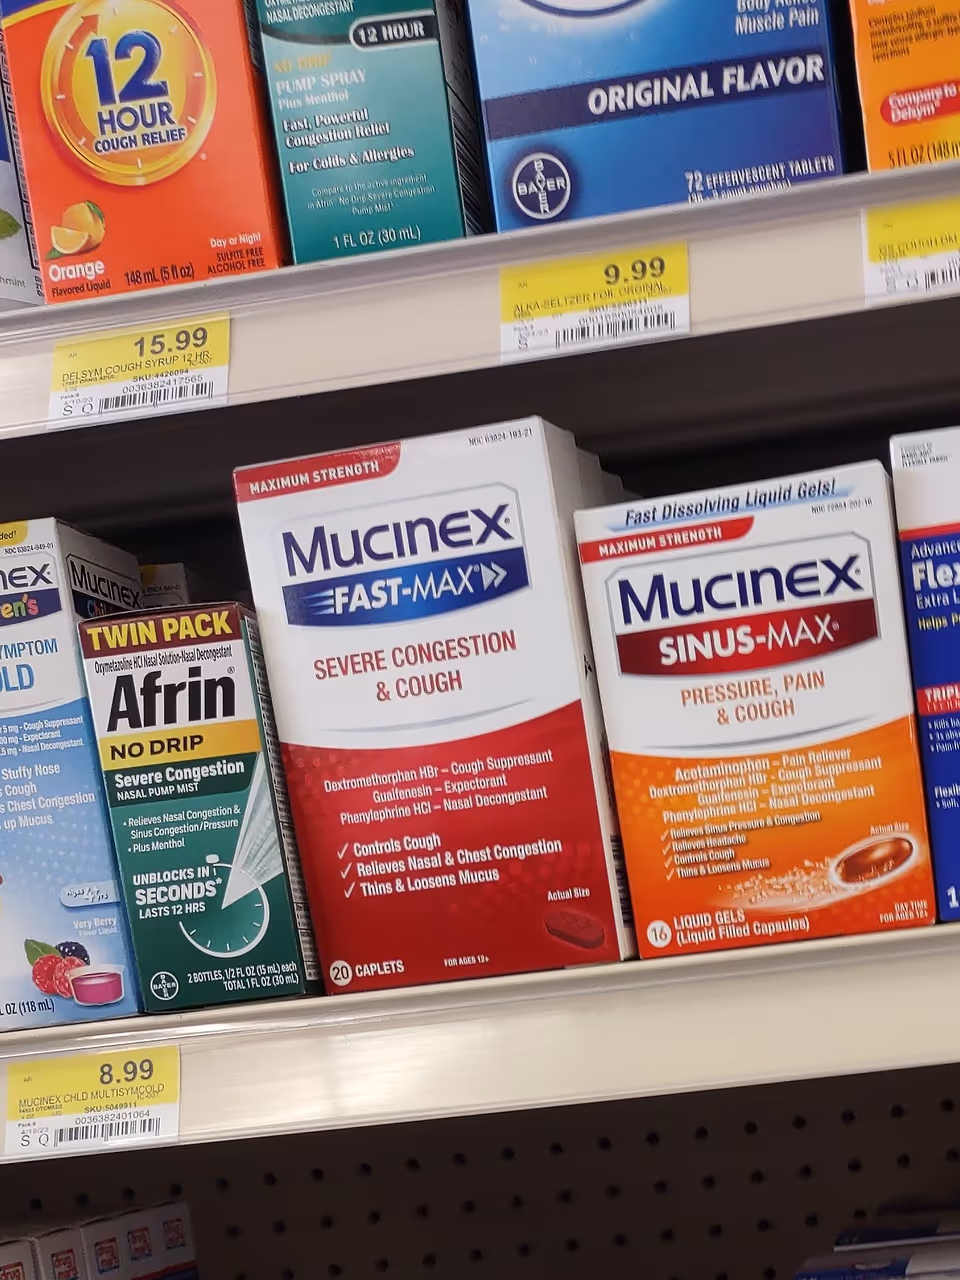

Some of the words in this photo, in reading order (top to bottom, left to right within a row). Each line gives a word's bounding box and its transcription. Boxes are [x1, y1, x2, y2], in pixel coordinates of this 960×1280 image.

[357, 26, 377, 44] 12
[381, 21, 425, 41] HOUR
[85, 29, 169, 106] 12
[588, 77, 714, 116] ORIGINAL
[722, 54, 824, 94] FLAVOR
[97, 102, 174, 136] HOUR
[94, 134, 139, 153] COUGH
[141, 129, 186, 146] RELIEF
[48, 260, 105, 282] Orange
[207, 260, 243, 274] ALCOHOL
[245, 257, 265, 270] FREE
[604, 257, 666, 285] 9.99
[134, 326, 209, 358] 15.99
[62, 367, 102, 383] DELSYM
[105, 360, 142, 376] COUGH
[145, 355, 180, 370] SYRUP
[250, 474, 309, 494] MAXIMUM
[314, 461, 380, 482] STRENGTH
[625, 508, 658, 528] Fast
[662, 491, 740, 521] Dissolving
[746, 482, 793, 509] Liquid
[798, 478, 836, 498] Gels!
[87, 622, 157, 651] TWIN
[164, 611, 232, 639] PACK
[314, 649, 387, 681] SEVERE
[392, 629, 517, 668] CONGESTION
[376, 681, 391, 701] &
[396, 670, 462, 699] COUGH
[681, 677, 778, 708] PRESSURE,
[784, 670, 826, 693] PAIN
[716, 706, 729, 726] &
[736, 698, 795, 723] COUGH
[110, 742, 144, 760] NO
[150, 734, 204, 751] DRIP
[115, 767, 163, 789] Severe
[166, 759, 244, 782] Congestion
[117, 788, 146, 801] NASAL
[148, 786, 175, 799] PUMP
[177, 782, 200, 795] MIST
[133, 842, 149, 853] Plus
[151, 838, 185, 851] Menthol
[354, 840, 401, 858] Controls
[404, 833, 441, 851] Cough
[133, 868, 195, 886] UNBLOCKS
[198, 866, 209, 878] IN
[674, 911, 712, 929] LIQUID
[715, 908, 745, 925] GELS
[651, 926, 667, 942] 16
[332, 966, 350, 981] 20
[356, 960, 404, 979] CAPLETS
[99, 1059, 154, 1085] 8.99
[19, 1096, 61, 1108] MUCINEX
[64, 1091, 89, 1104] CHLD
[91, 1083, 164, 1101] MULTISYMCOLD
